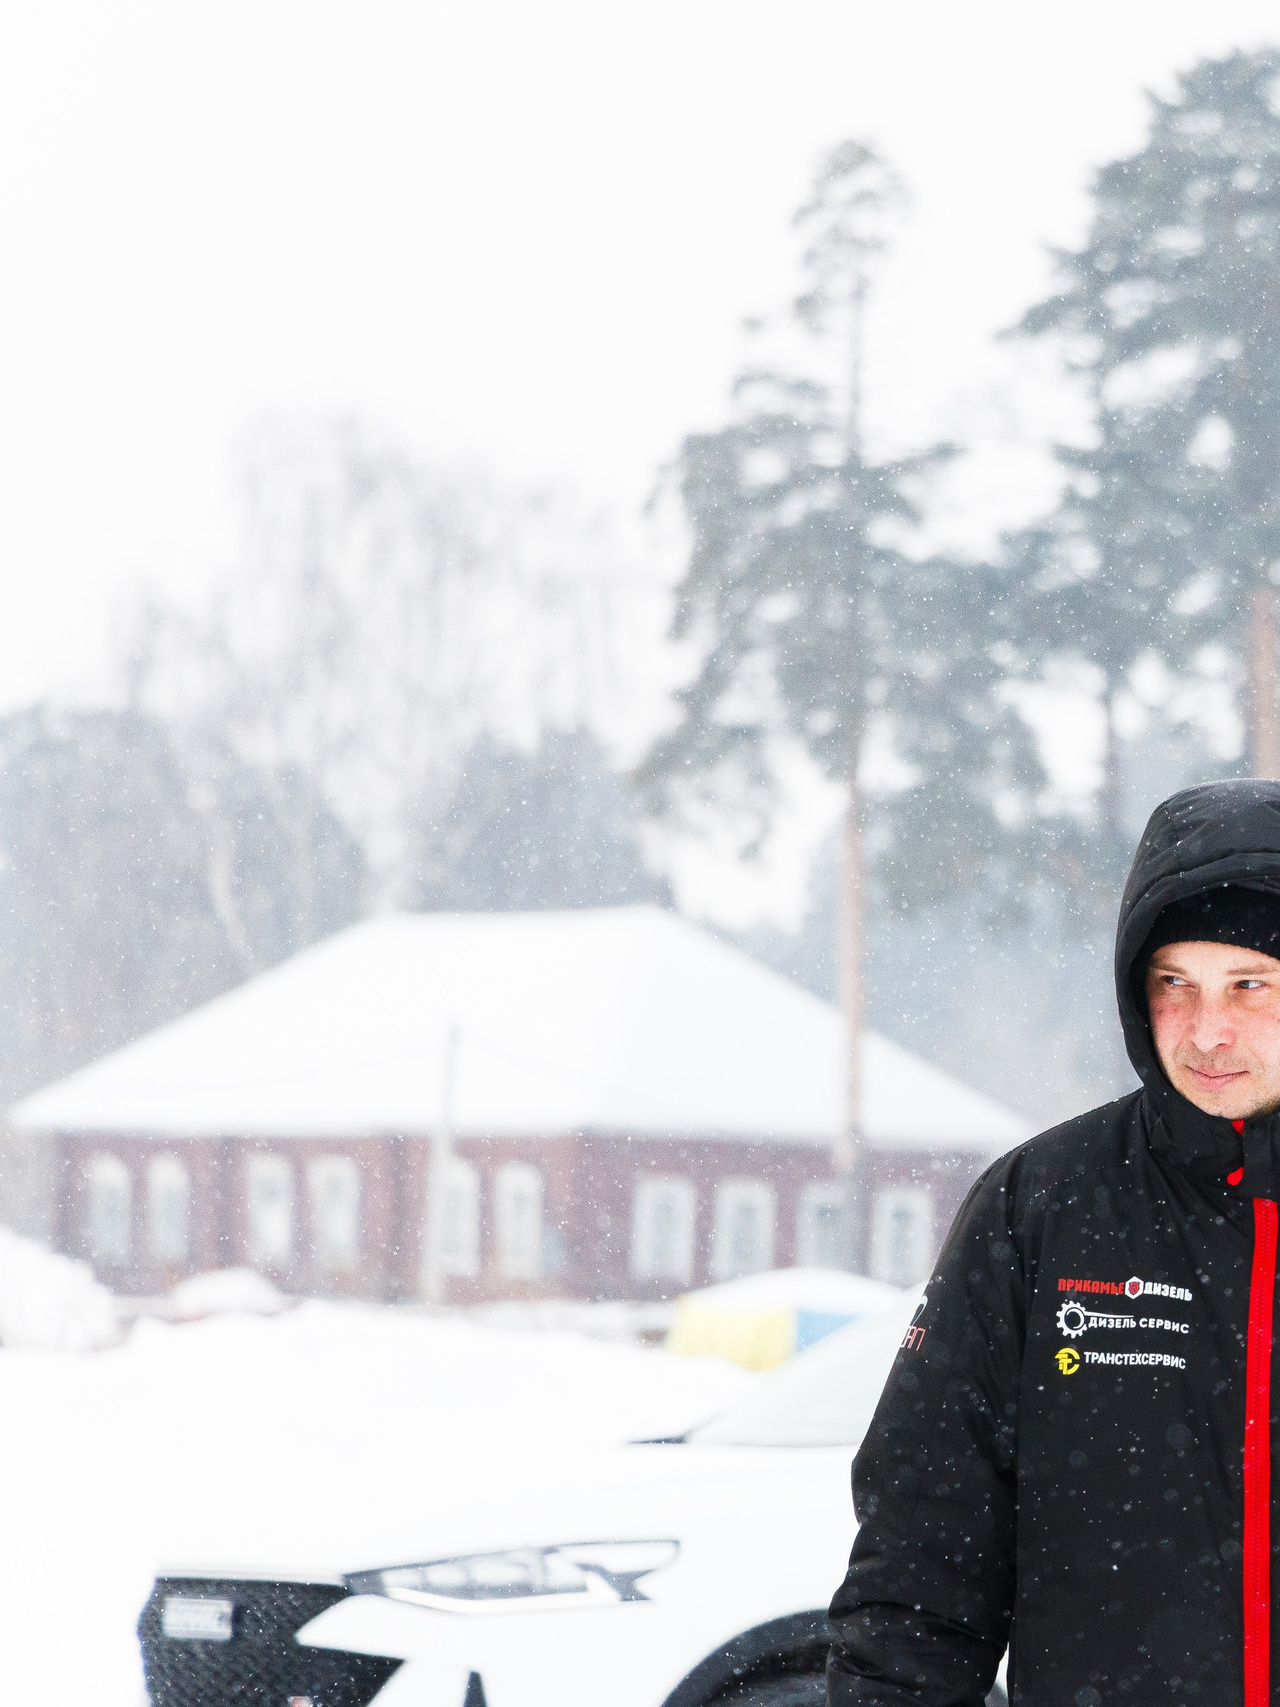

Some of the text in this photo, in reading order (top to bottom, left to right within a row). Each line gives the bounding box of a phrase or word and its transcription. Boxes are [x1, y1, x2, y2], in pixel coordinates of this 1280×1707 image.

[1057, 1278, 1193, 1302] ПРИКАМЬЕ ДИЗЕЛЬ
[1088, 1316, 1190, 1334] ДИЗЕЛЬ СЕРВИС
[1083, 1351, 1187, 1370] ТРАНСТЕХСЕРВИС
